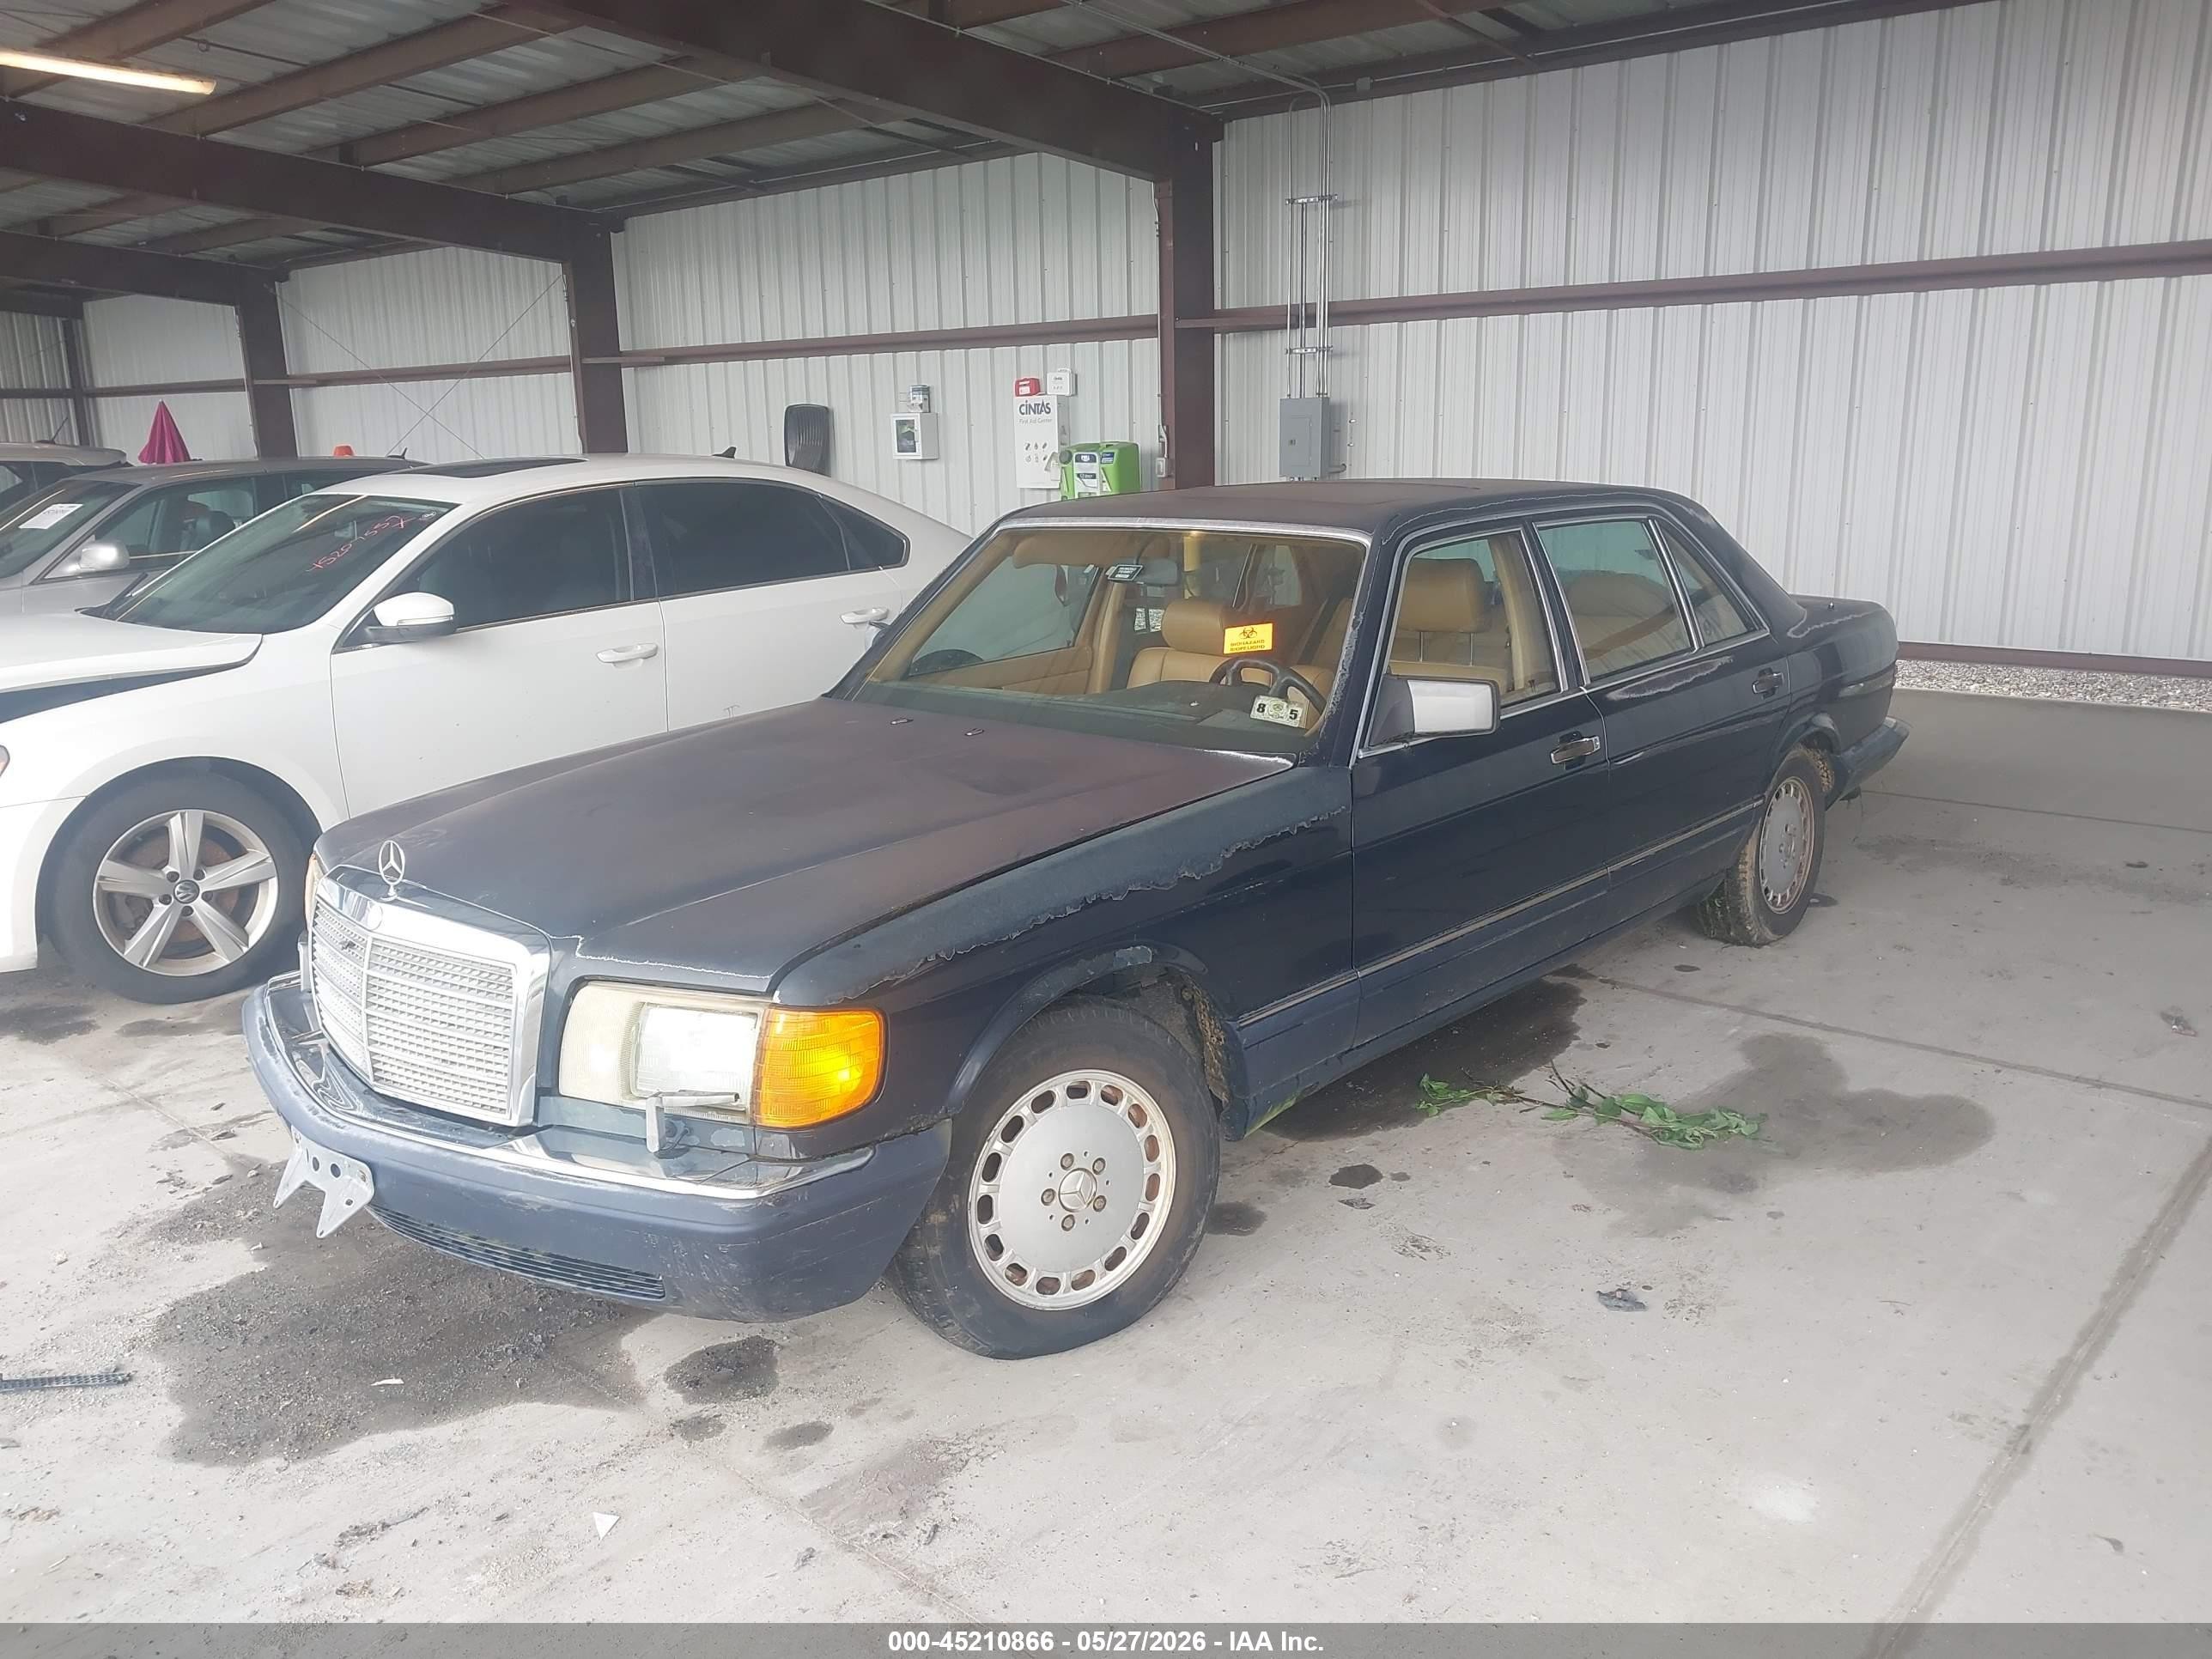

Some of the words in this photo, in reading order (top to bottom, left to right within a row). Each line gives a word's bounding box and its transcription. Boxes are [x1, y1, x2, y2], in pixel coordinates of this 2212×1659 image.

[1018, 398, 1052, 416] CINTAS
[1256, 702, 1267, 714] 8
[1289, 708, 1298, 720] 5
